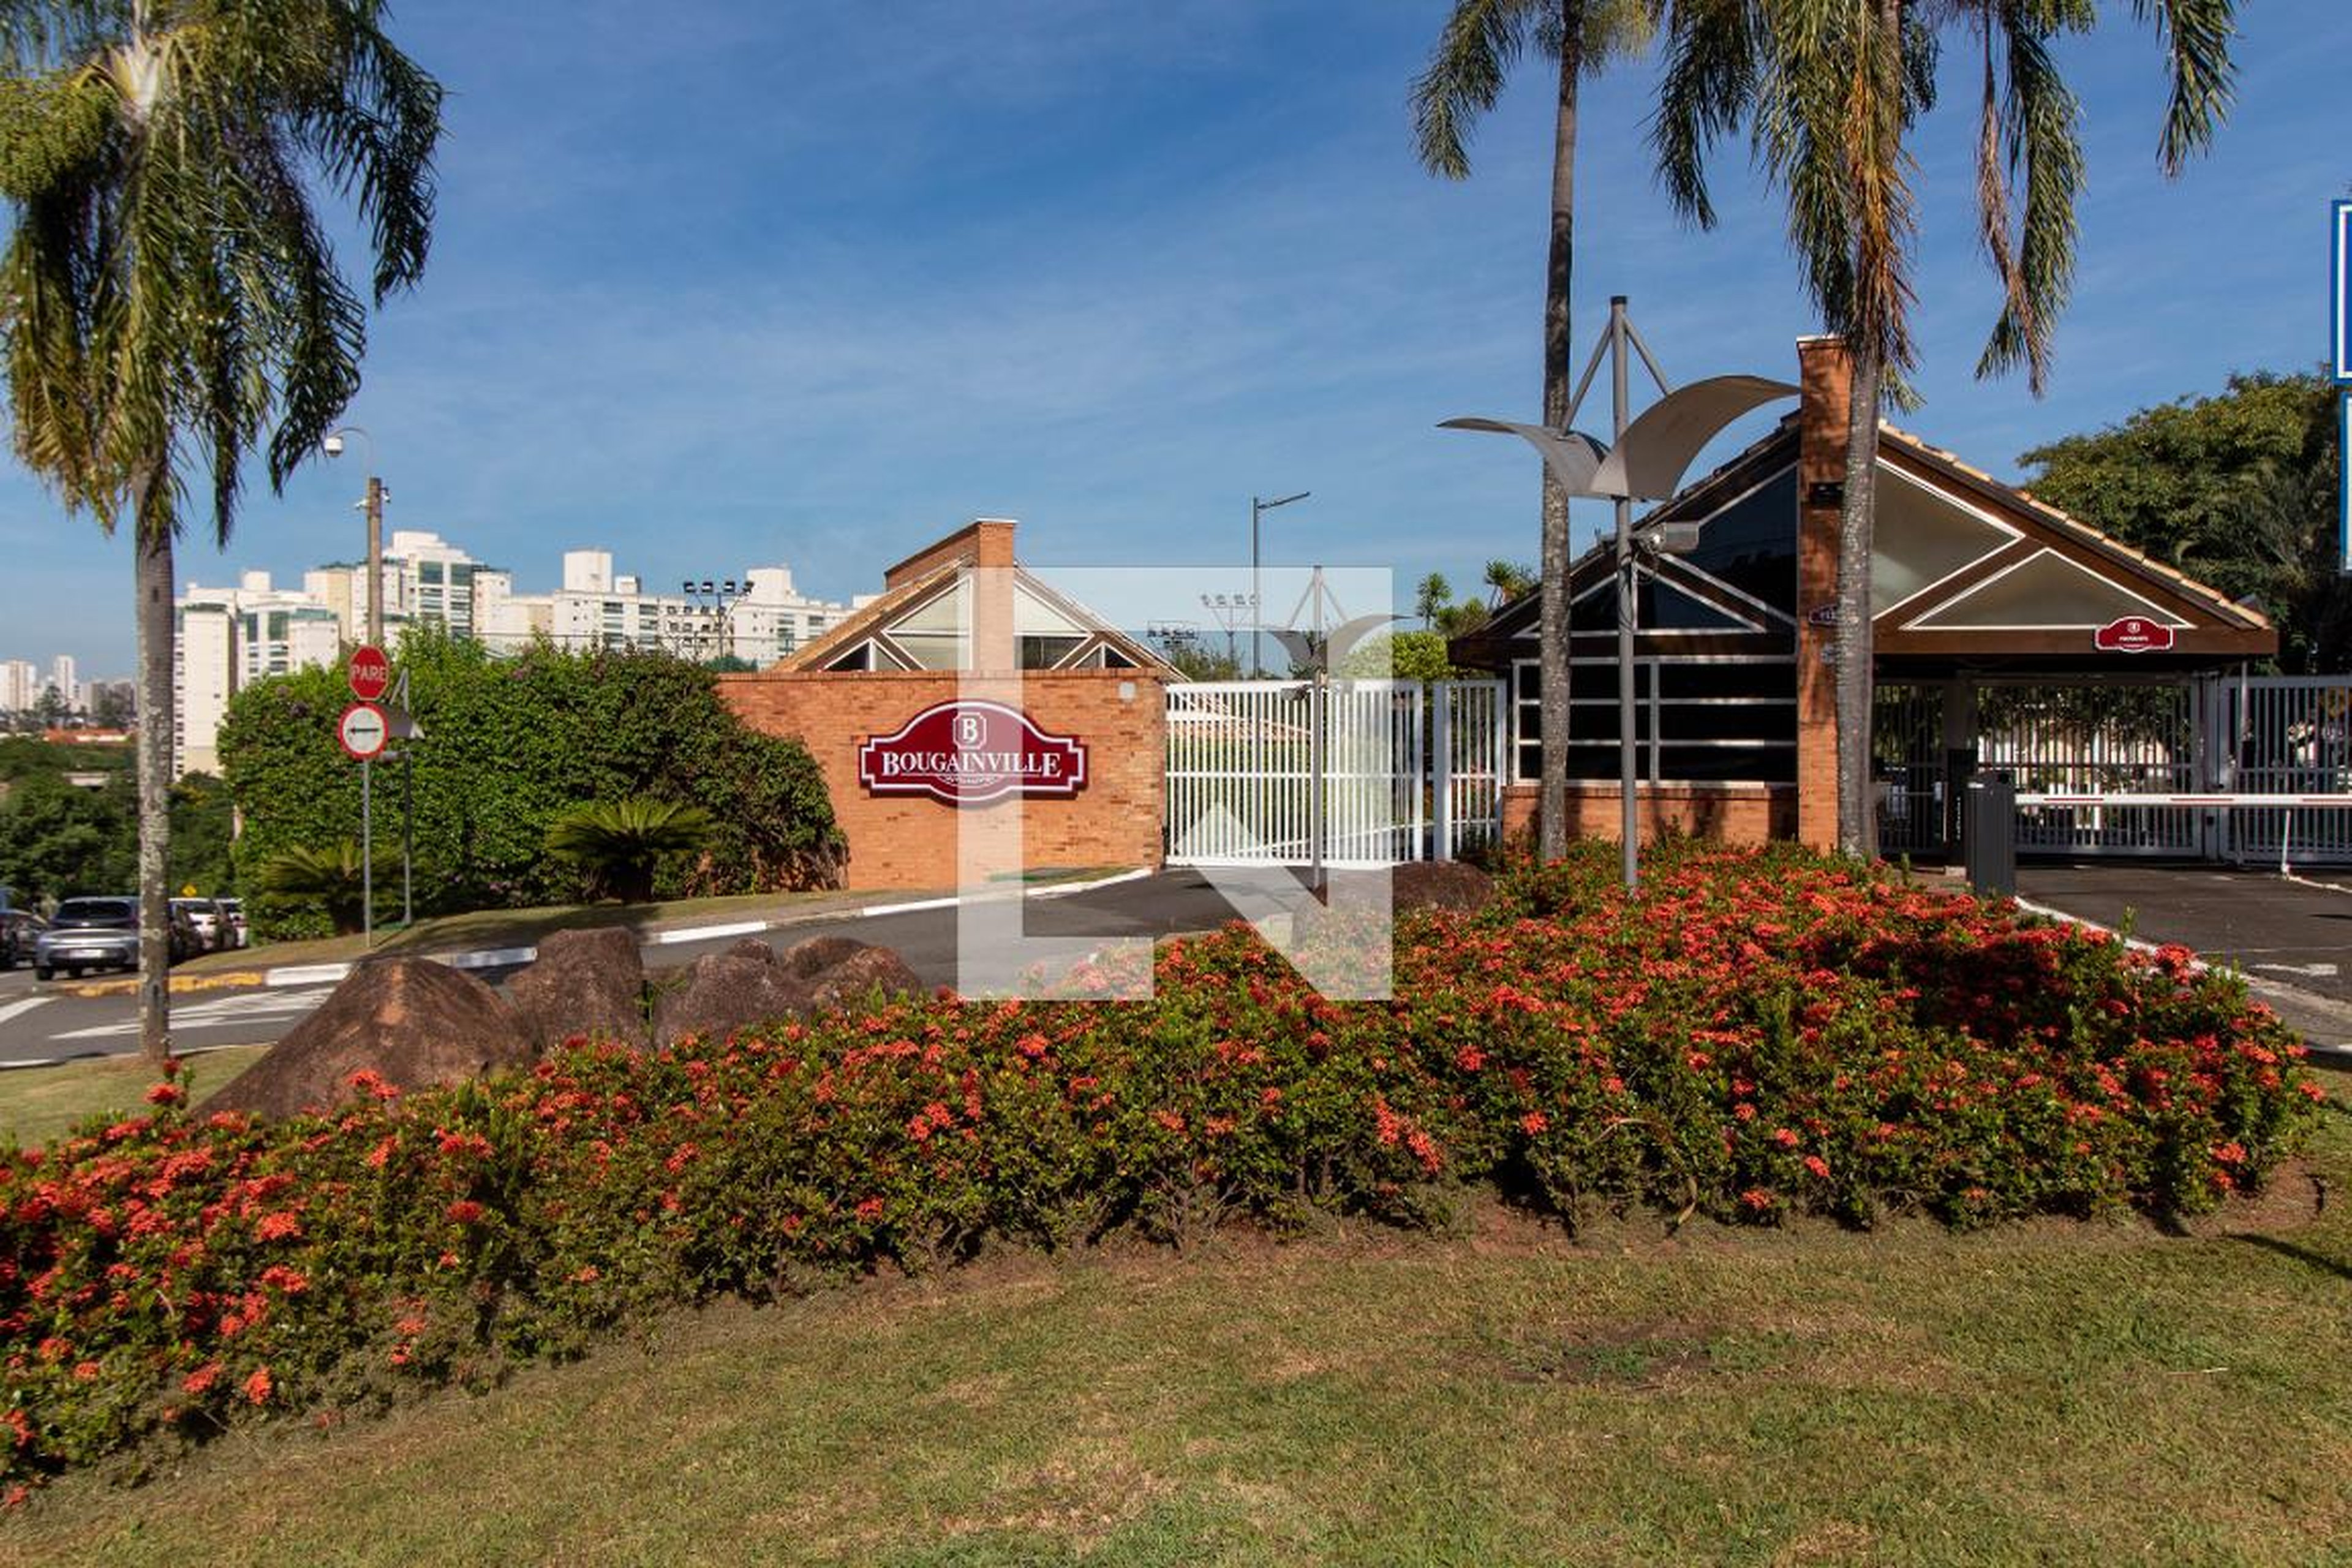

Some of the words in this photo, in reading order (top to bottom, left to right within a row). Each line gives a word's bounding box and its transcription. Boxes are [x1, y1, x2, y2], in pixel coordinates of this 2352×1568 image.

[351, 665, 386, 682] PARE
[962, 718, 978, 742] B
[882, 752, 1061, 777] BOUGAINVILLE
